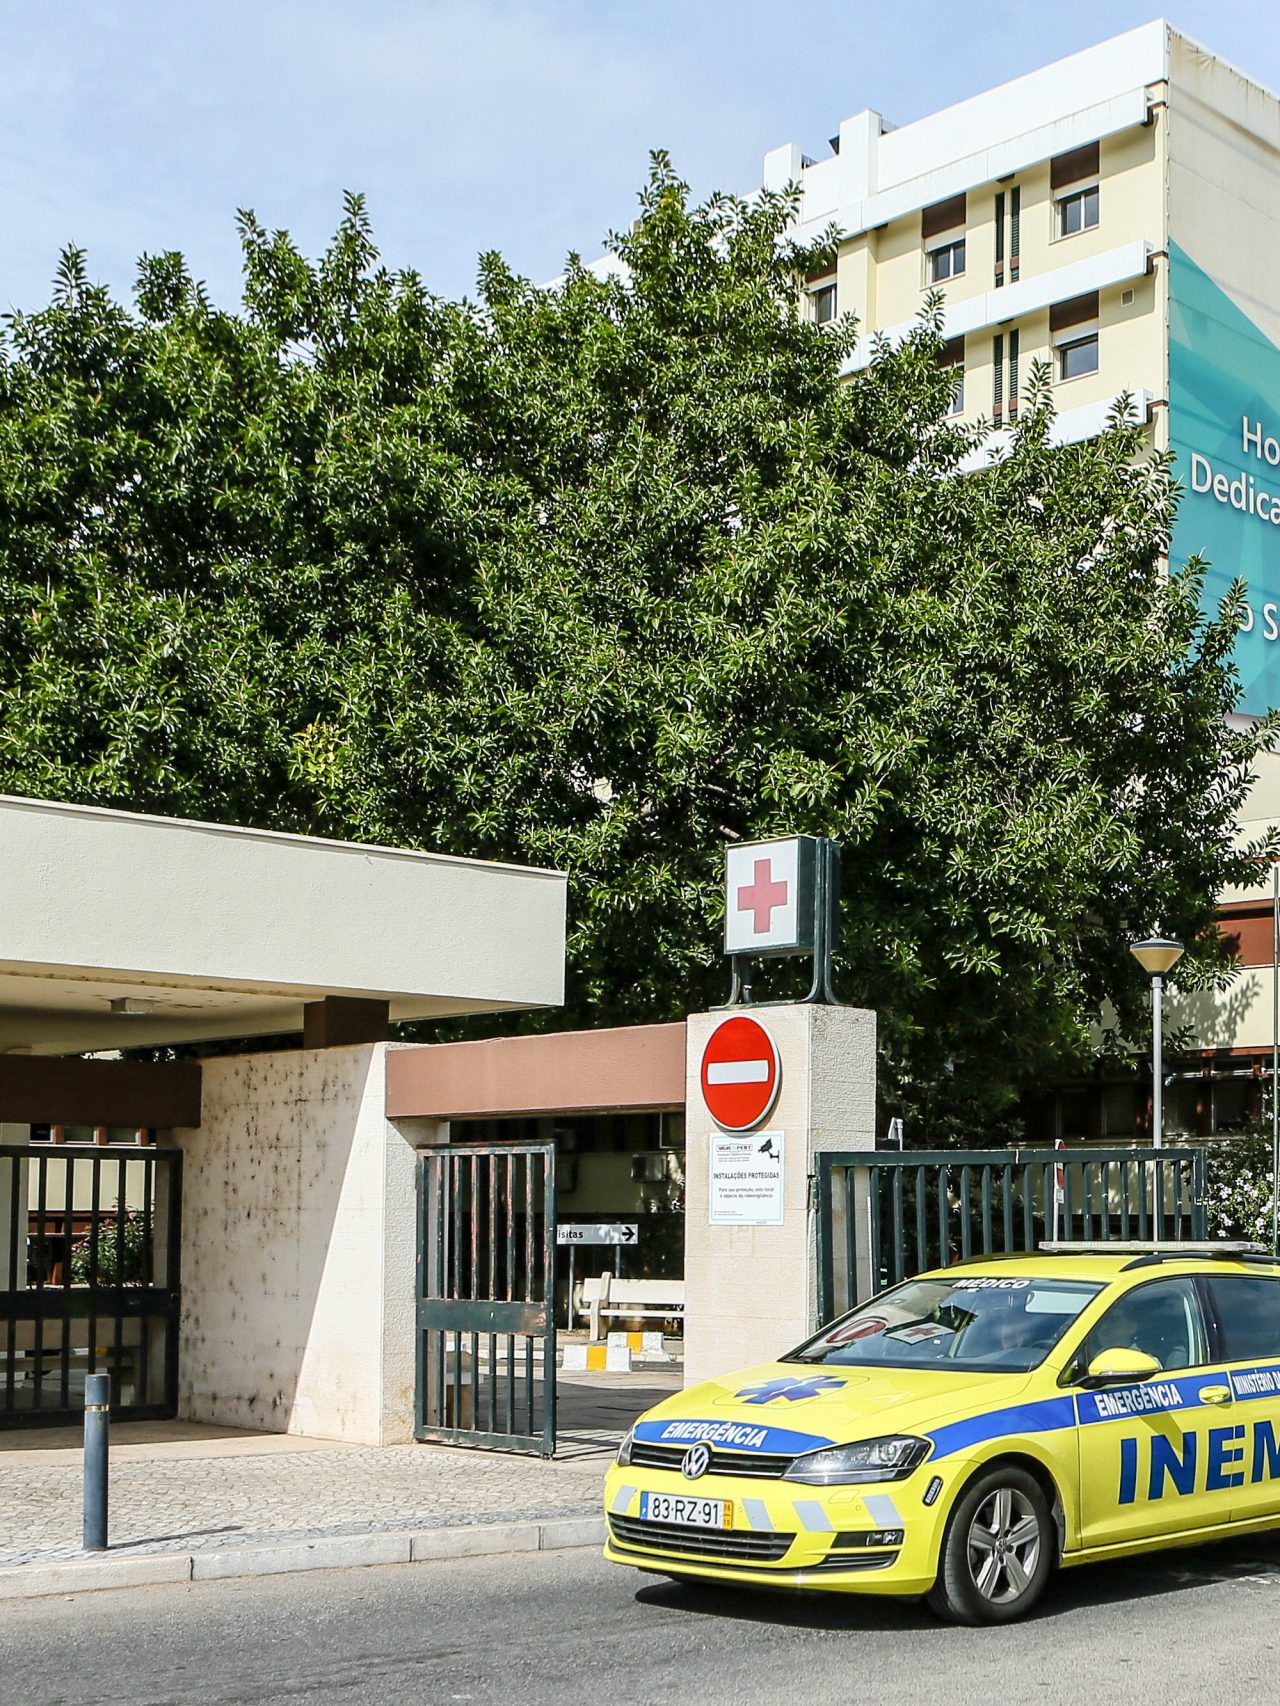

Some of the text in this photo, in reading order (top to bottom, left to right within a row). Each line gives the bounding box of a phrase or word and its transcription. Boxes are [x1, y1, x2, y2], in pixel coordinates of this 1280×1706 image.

[748, 1171, 780, 1179] PROTEGIDAS
[557, 1229, 584, 1239] isitas
[952, 1277, 1031, 1289] MÉDICO
[1232, 1368, 1276, 1395] MINISTÉRIO
[1093, 1383, 1183, 1418] EMERGÊNCIA
[660, 1422, 768, 1448] EMERGÊNCIA
